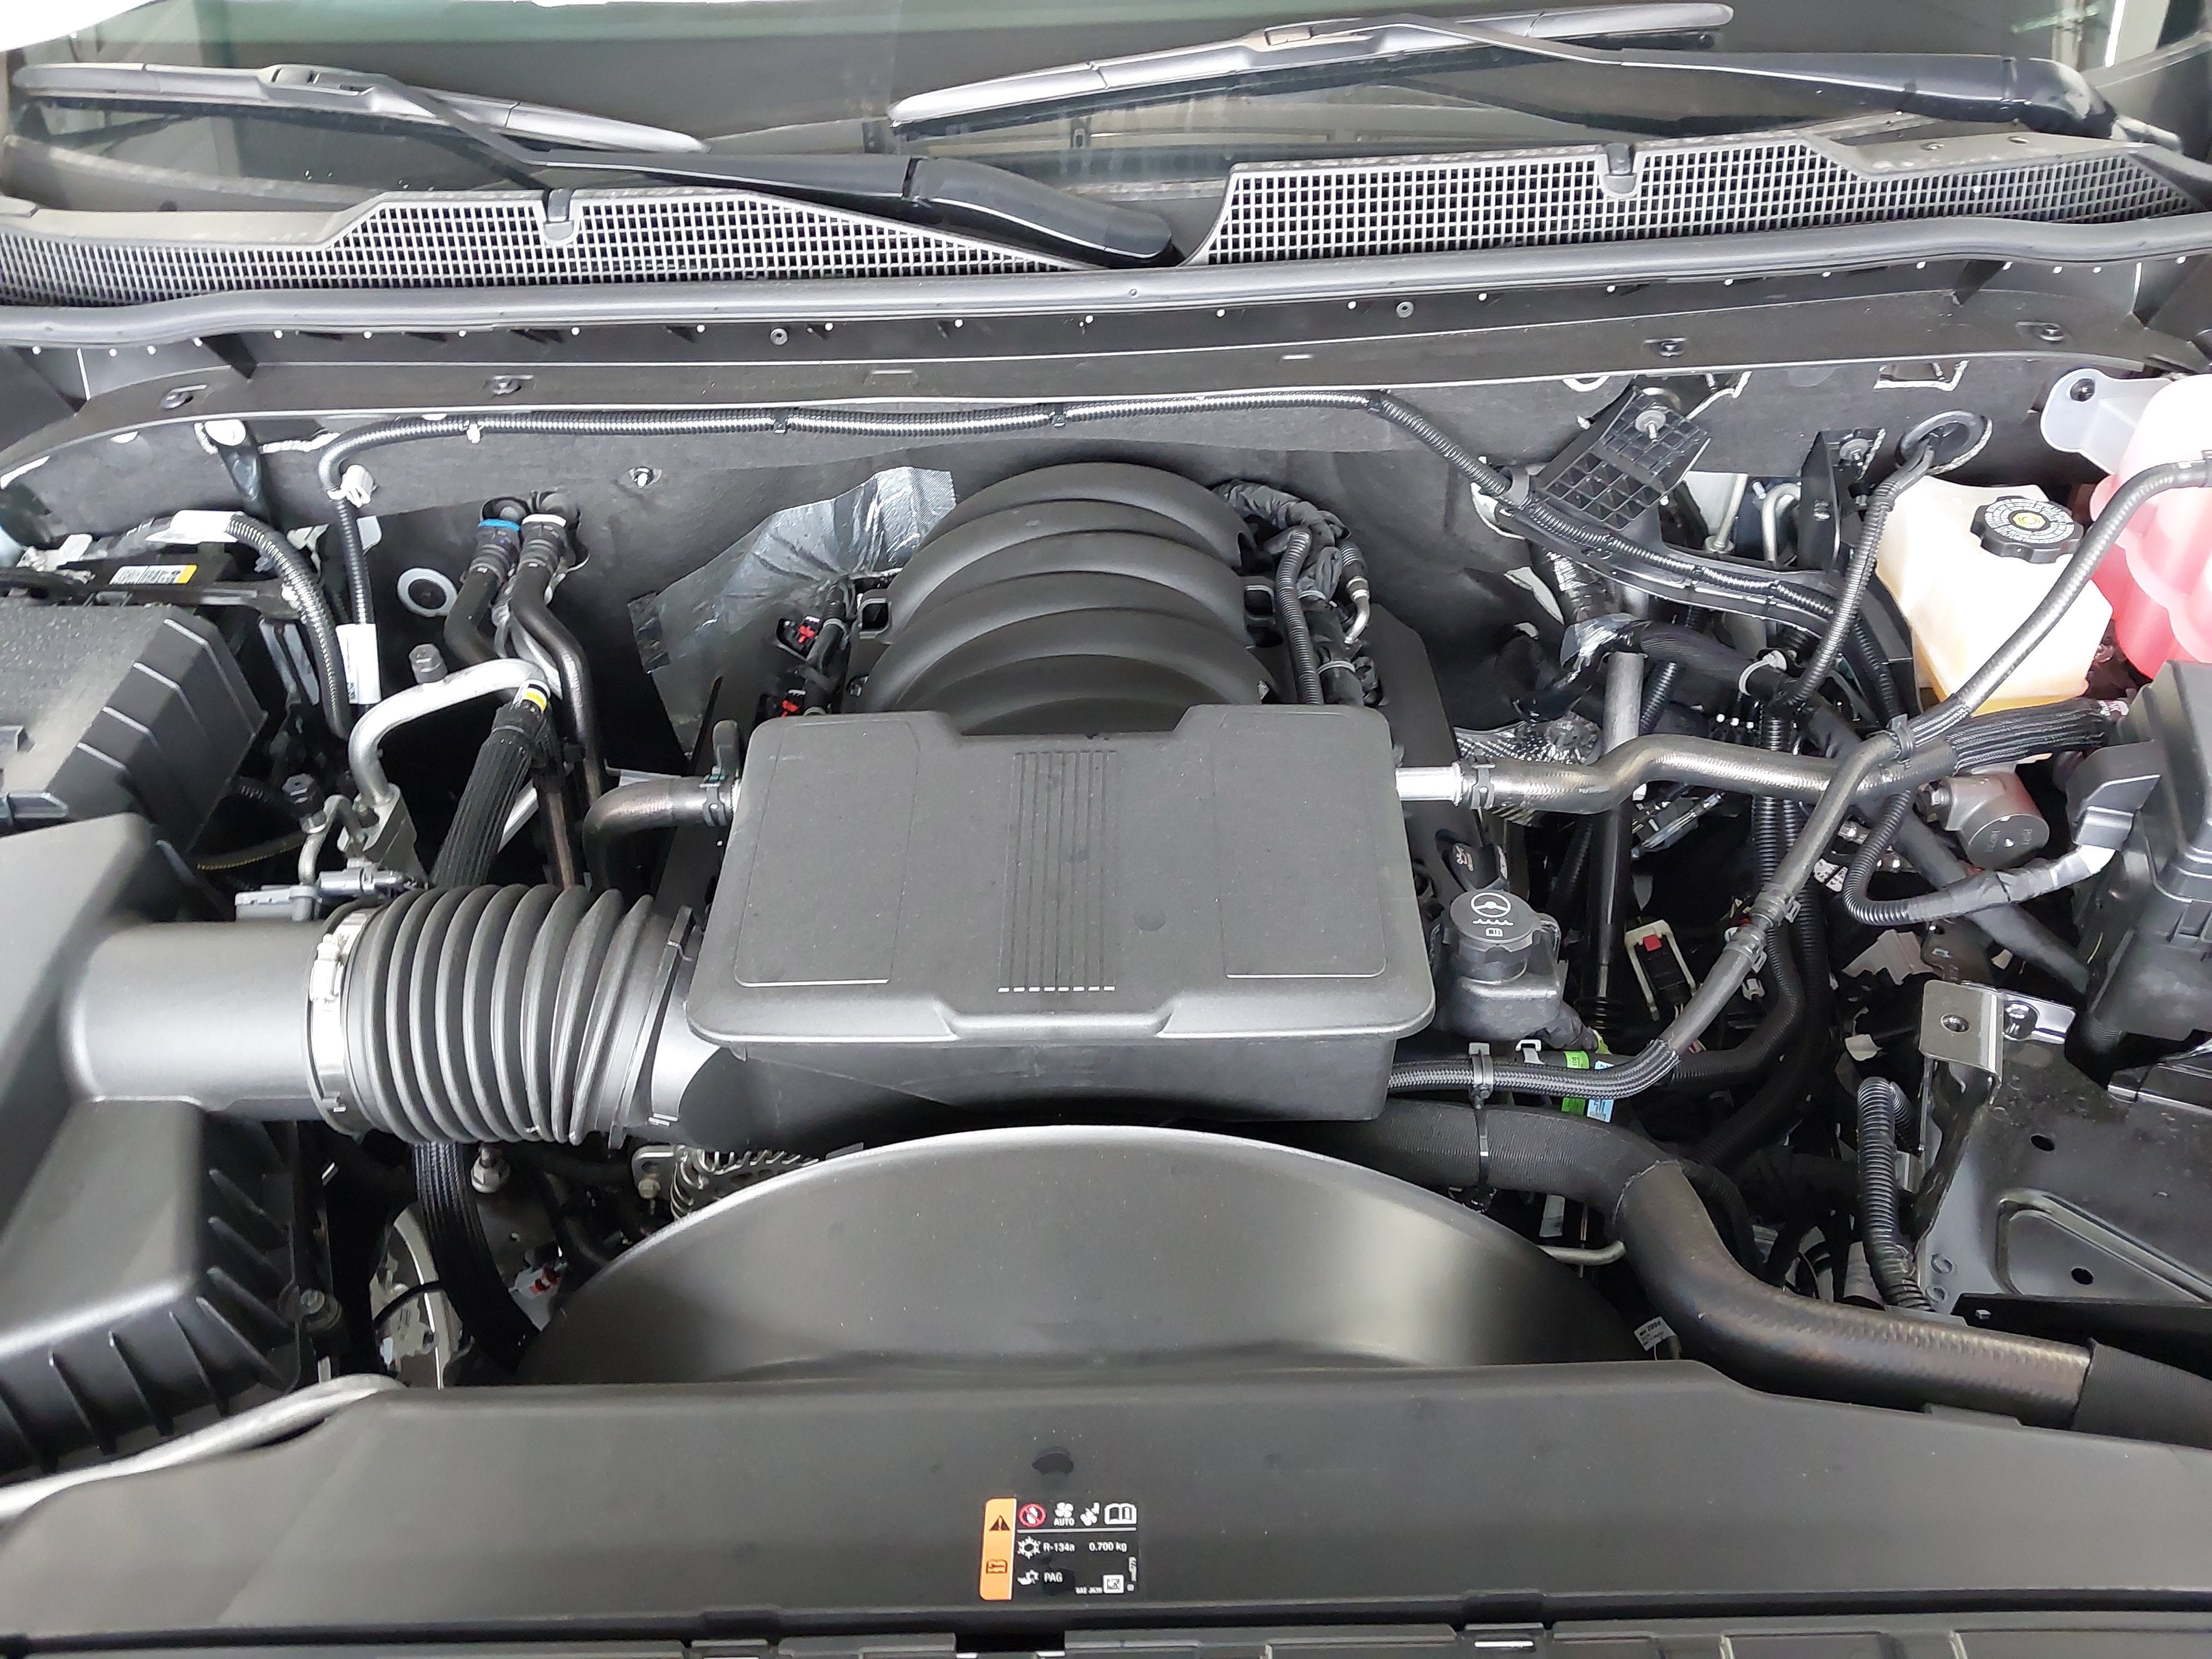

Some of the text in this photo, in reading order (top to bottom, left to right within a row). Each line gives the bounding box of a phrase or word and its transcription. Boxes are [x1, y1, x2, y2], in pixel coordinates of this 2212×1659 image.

[1053, 1518, 1075, 1526] AUTO
[1089, 1541, 1114, 1552] 0.700
[1044, 1572, 1064, 1583] PAG
